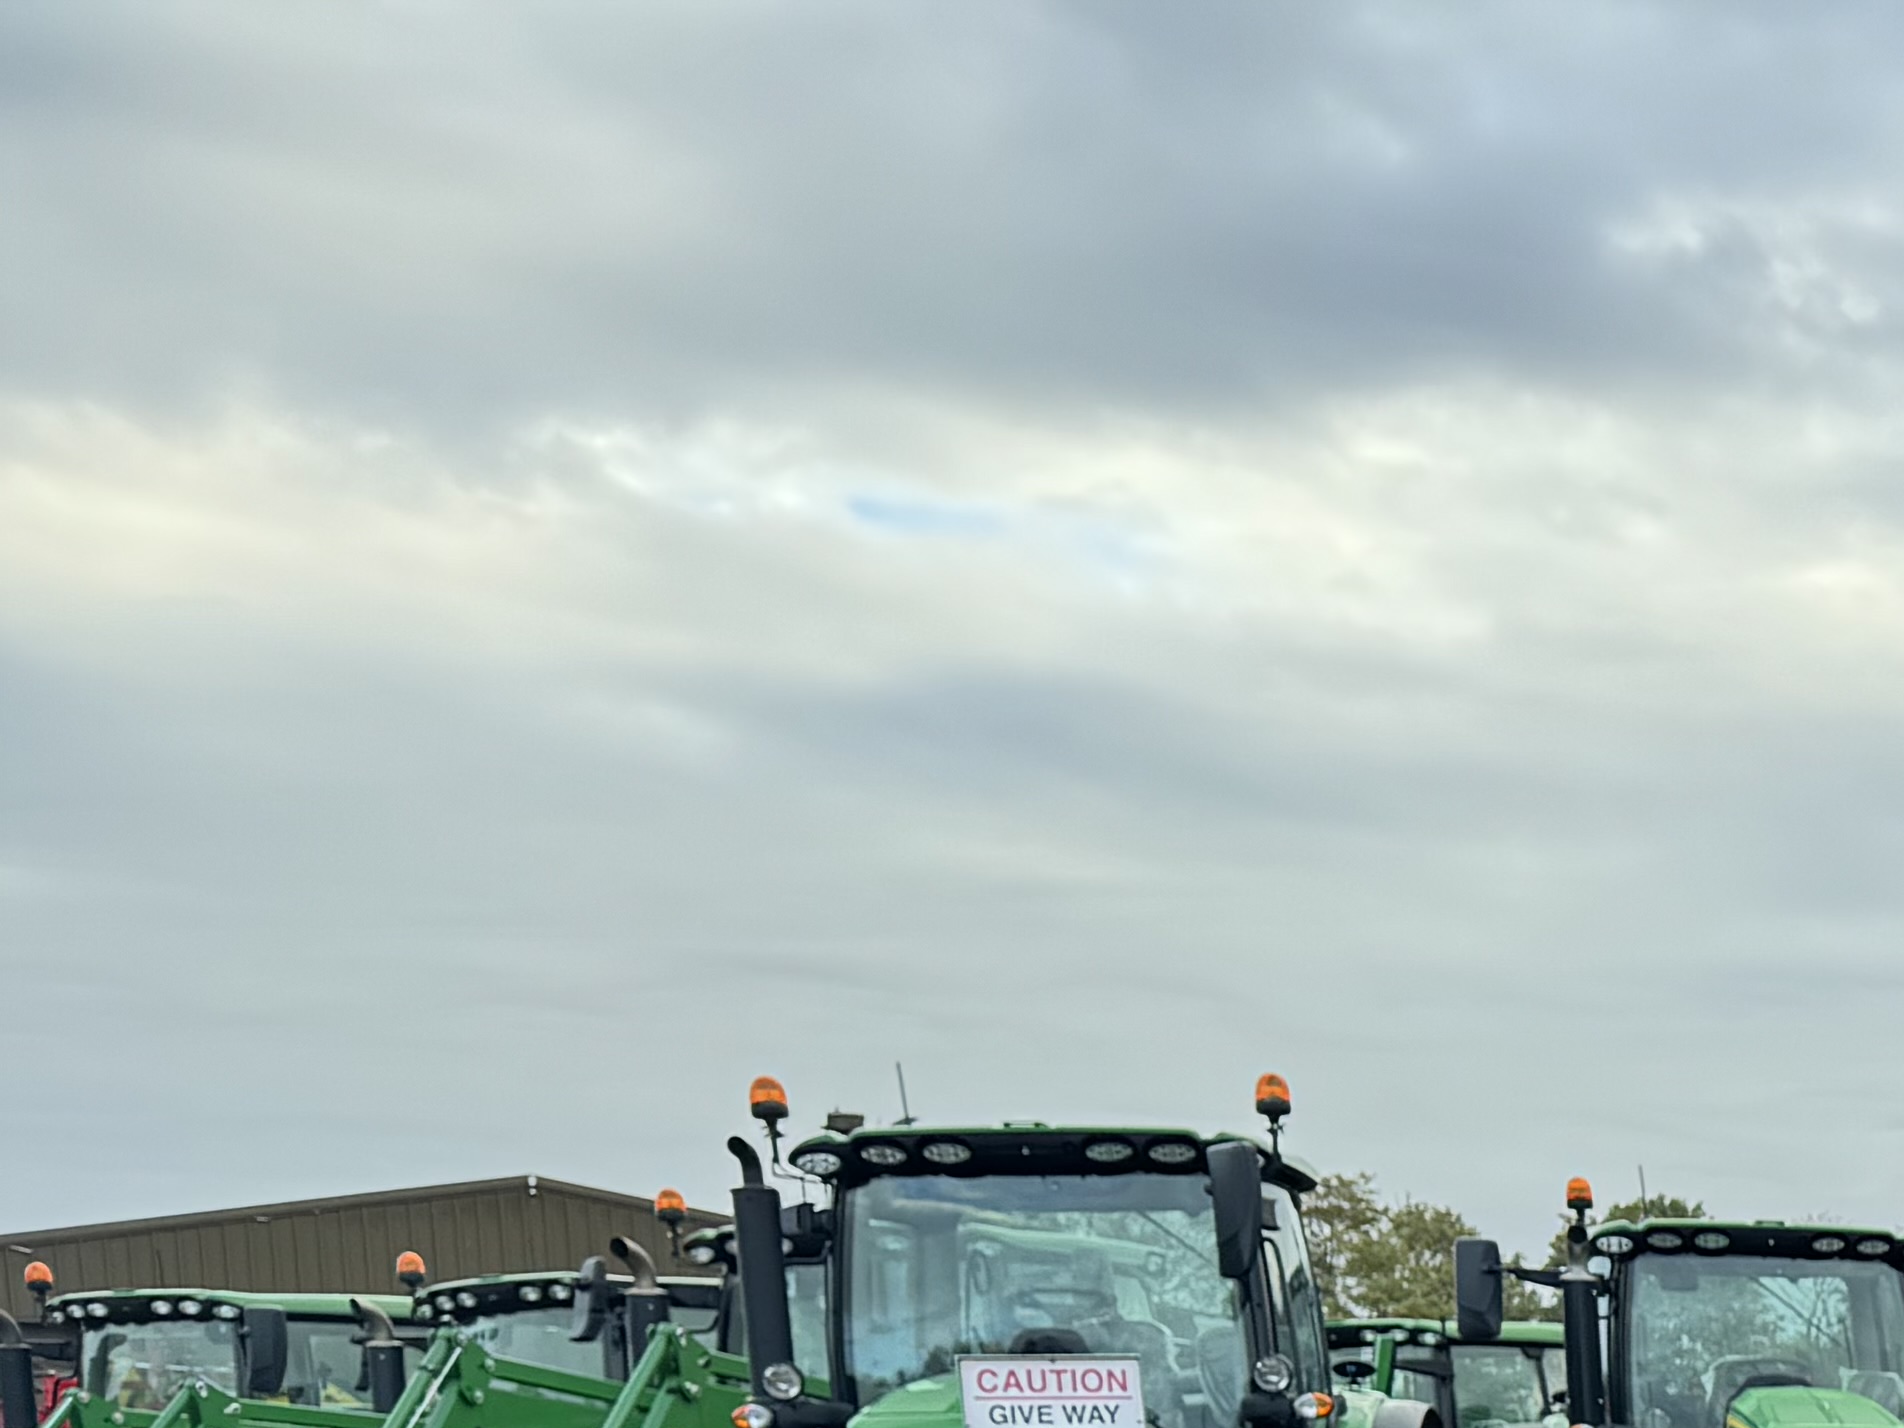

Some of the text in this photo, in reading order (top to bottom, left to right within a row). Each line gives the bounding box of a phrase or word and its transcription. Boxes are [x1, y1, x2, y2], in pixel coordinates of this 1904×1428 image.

[976, 1368, 1129, 1393] CAUTION
[988, 1404, 1120, 1425] GIVE WAY
